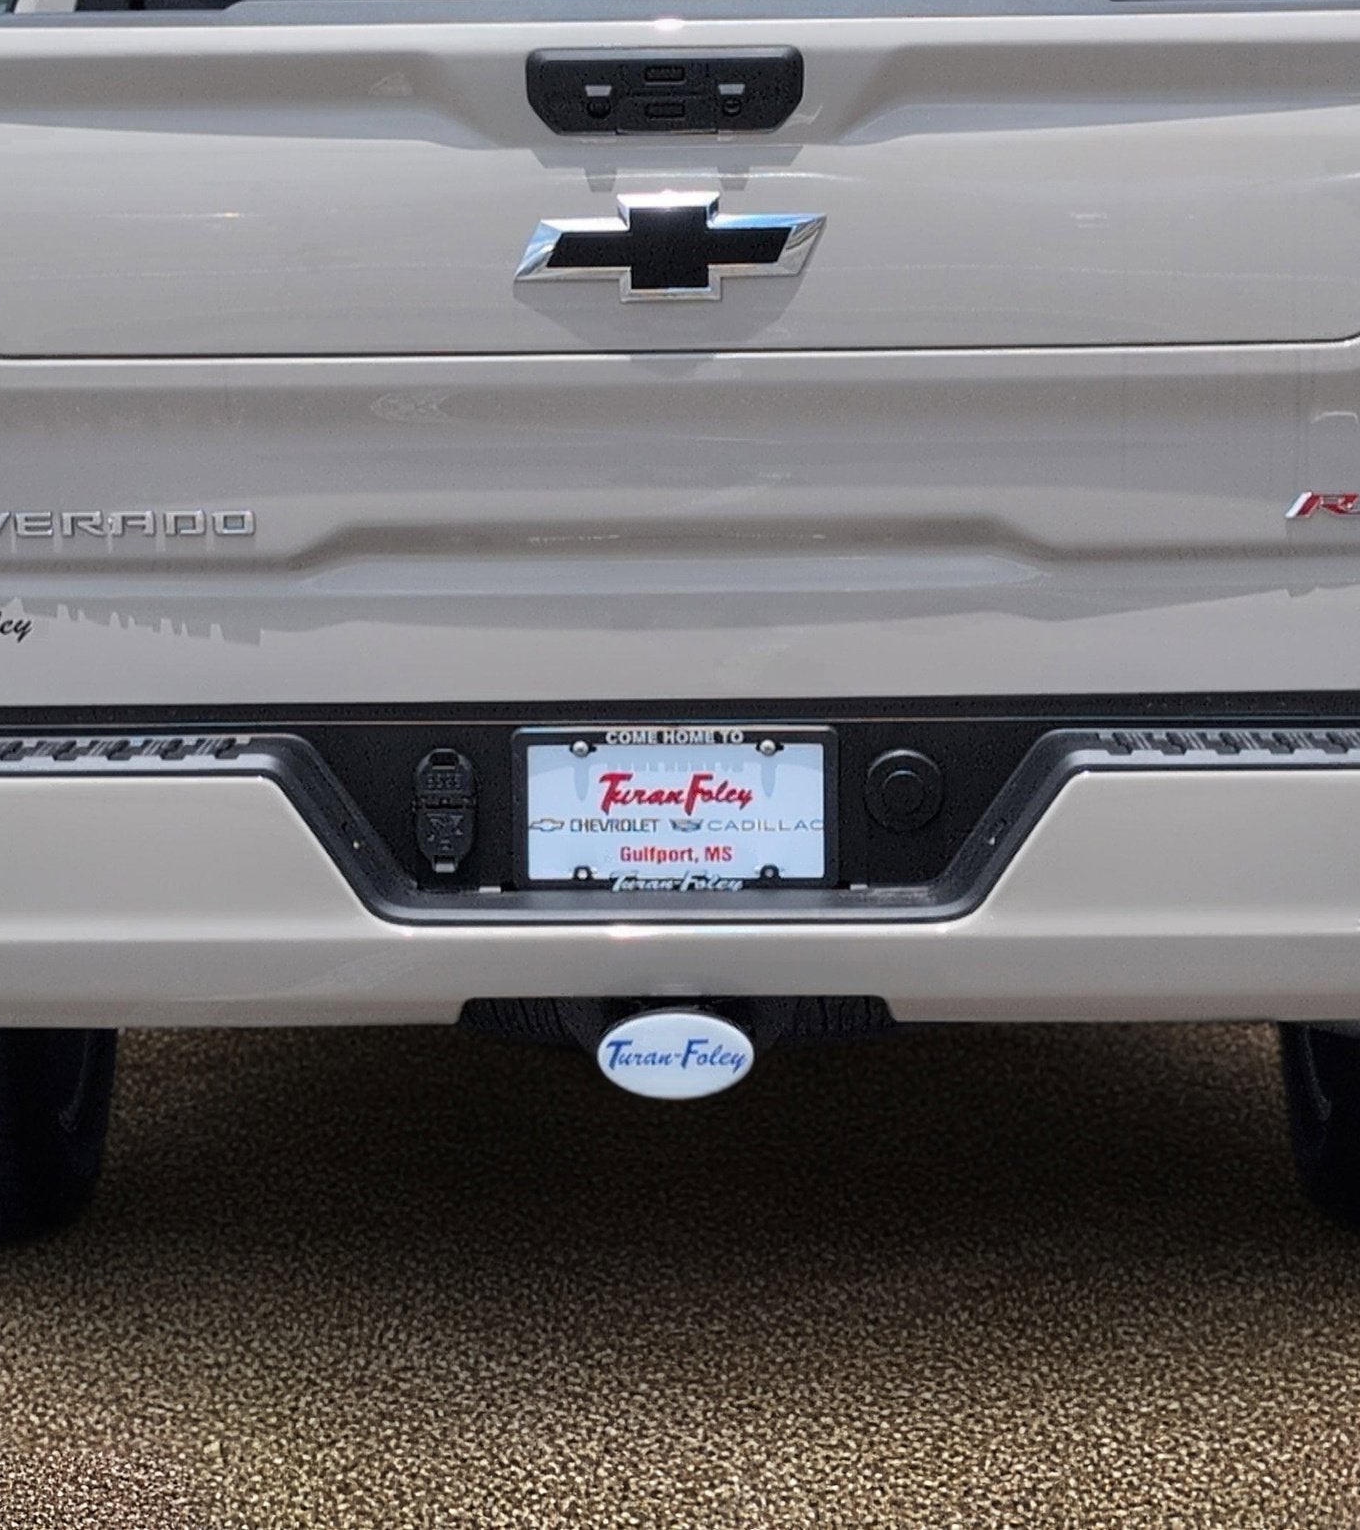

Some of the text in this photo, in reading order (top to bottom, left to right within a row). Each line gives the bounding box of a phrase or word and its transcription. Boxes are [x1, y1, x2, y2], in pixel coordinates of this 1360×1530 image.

[605, 729, 745, 744] COME HOME TO
[570, 818, 825, 833] CHEVROLET CADILLAC
[620, 846, 733, 864] Gulfport, MS
